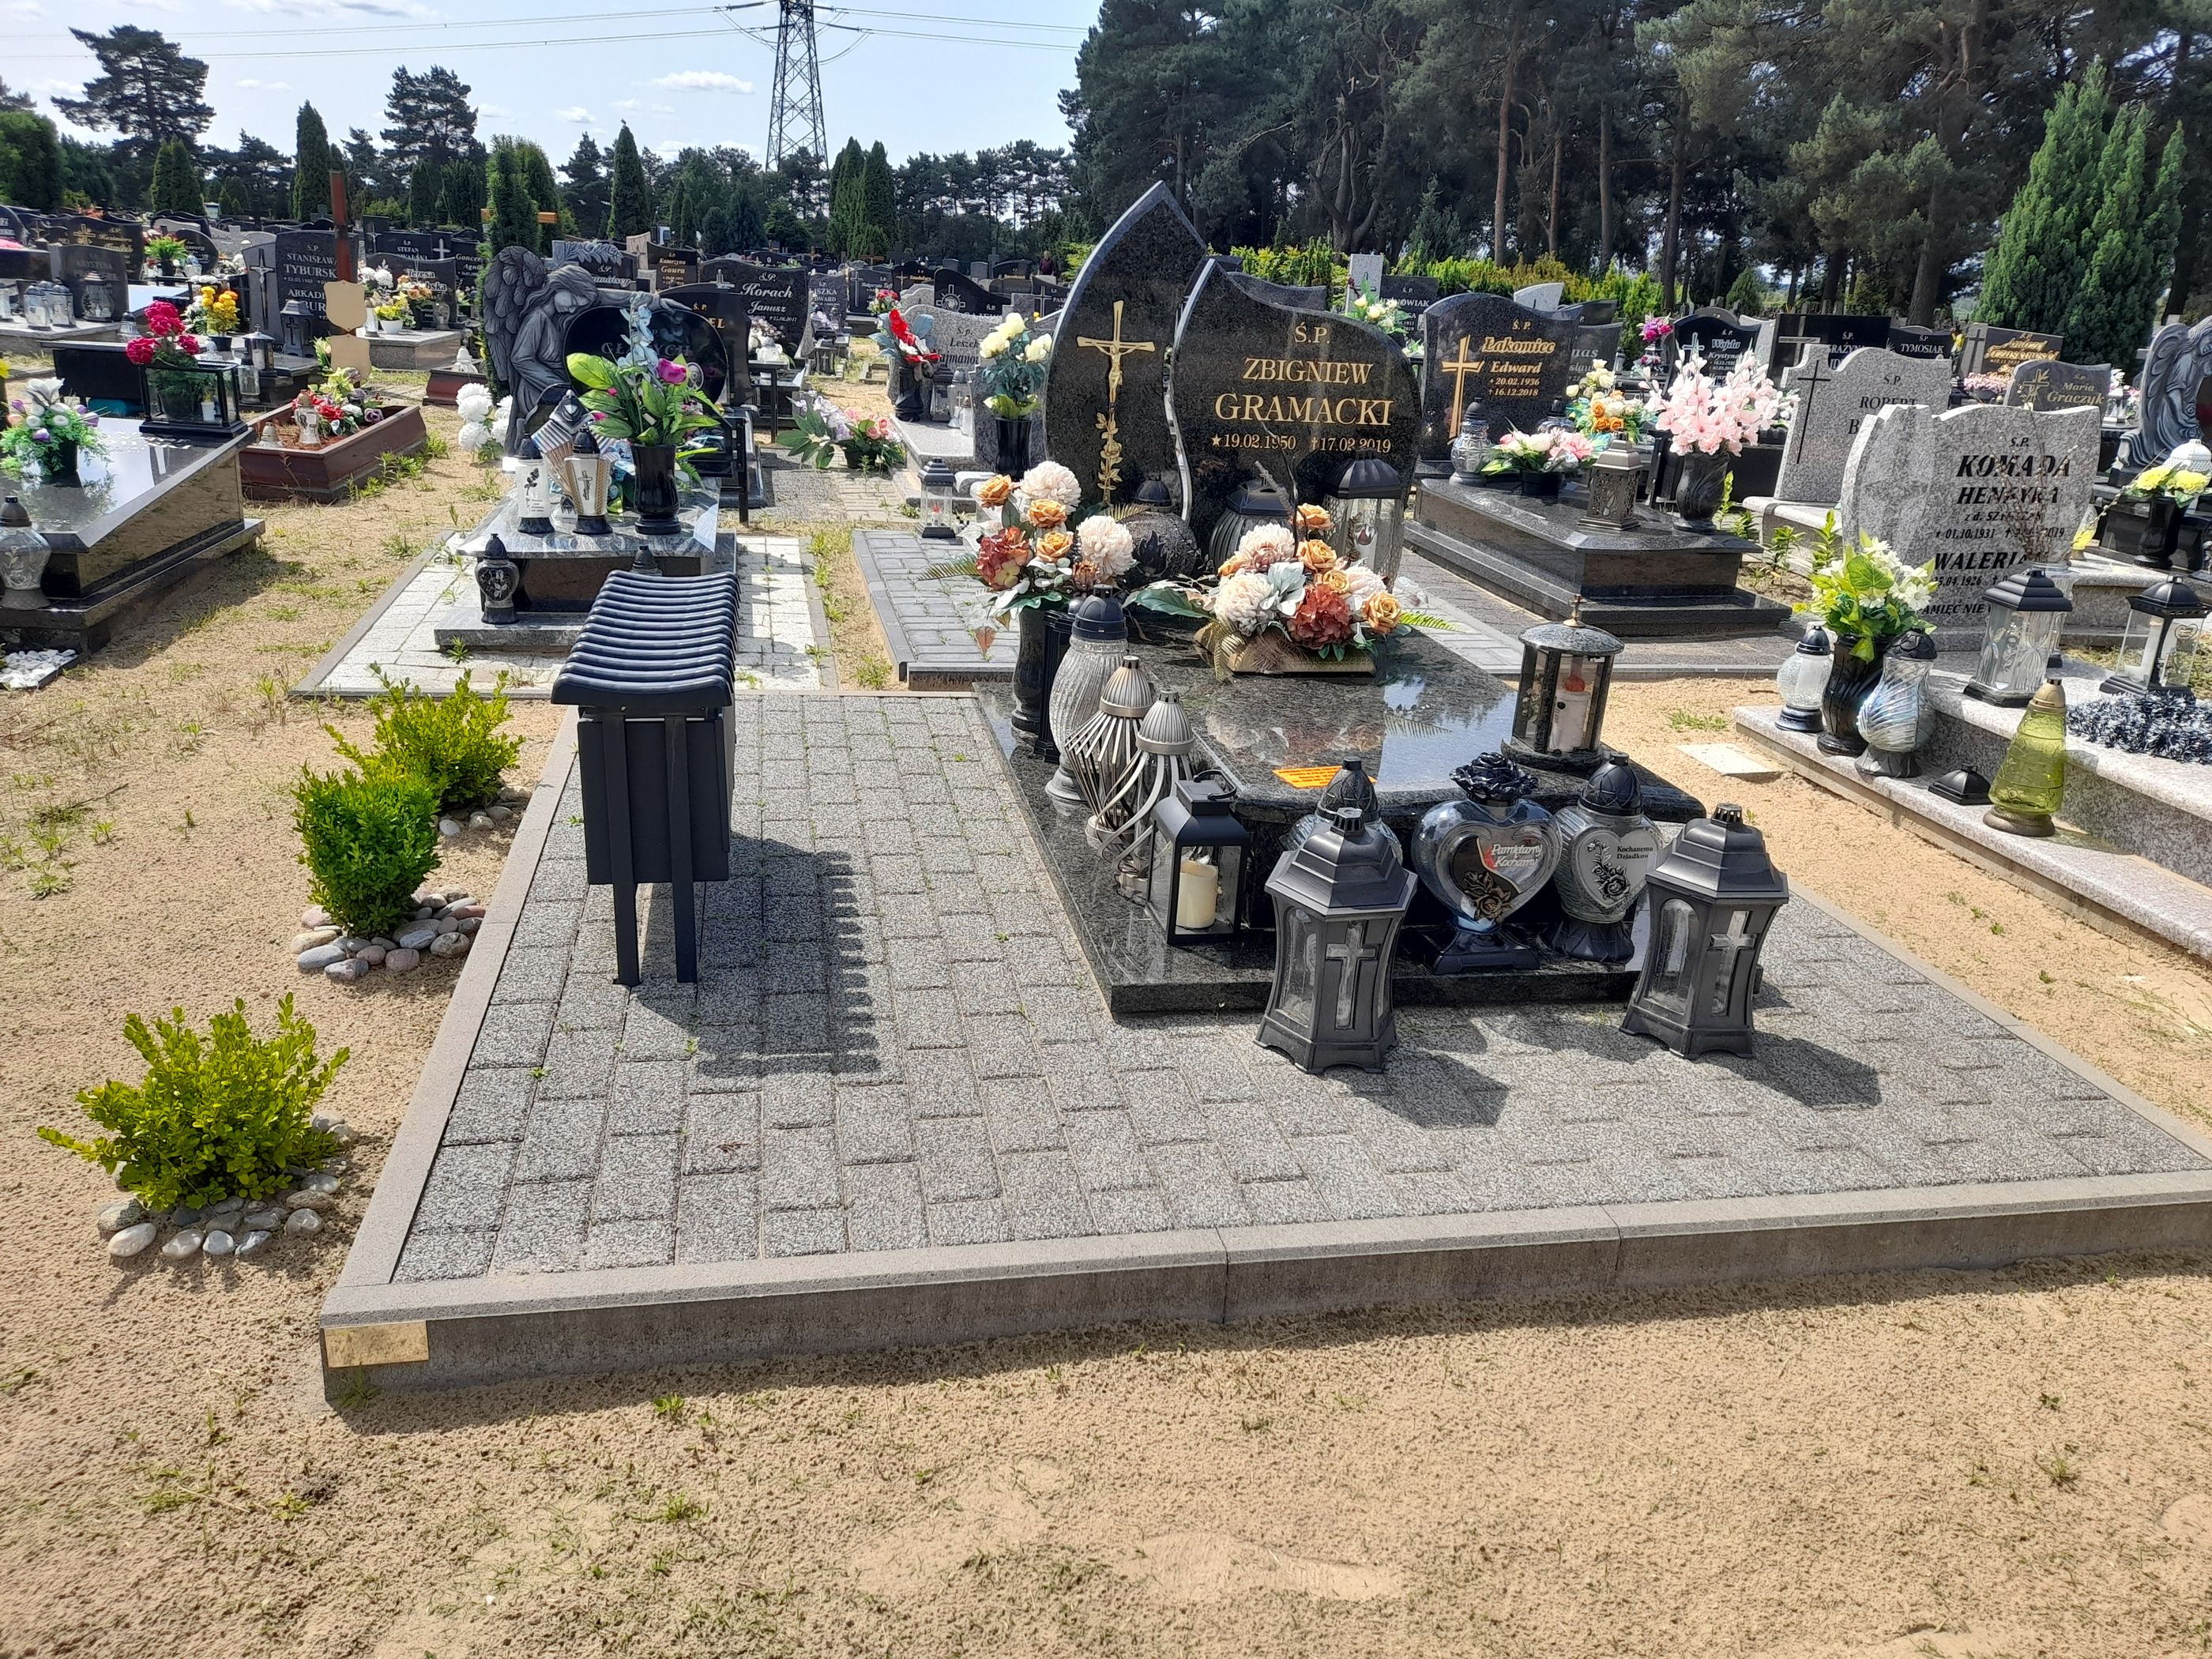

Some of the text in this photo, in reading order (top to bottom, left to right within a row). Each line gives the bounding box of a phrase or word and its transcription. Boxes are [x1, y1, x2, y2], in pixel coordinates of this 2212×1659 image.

[284, 265, 338, 279] TYBURSK
[407, 269, 435, 278] Teresa
[288, 289, 325, 299] ARKADI
[740, 282, 794, 299] Korach
[747, 300, 787, 314] Janusz
[1294, 322, 1331, 344] Ś.P.
[1482, 336, 1556, 354] Łakomiec
[1901, 344, 1944, 354] TYMOSIAK
[1242, 356, 1374, 386] ZBIGNIEW
[1490, 361, 1543, 374] Edward
[1495, 377, 1540, 386] 20.02.1936
[2061, 382, 2094, 392] Maria
[1494, 388, 1539, 397] 16.12.2018
[2047, 391, 2105, 405] Graczyk
[1214, 393, 1394, 426] GRAMACKI
[1224, 434, 1297, 450] 19.02.1950
[1955, 454, 2071, 477] KOMADA
[1945, 529, 1996, 540] 01.10.1931
[1964, 604, 1985, 614] NIE
